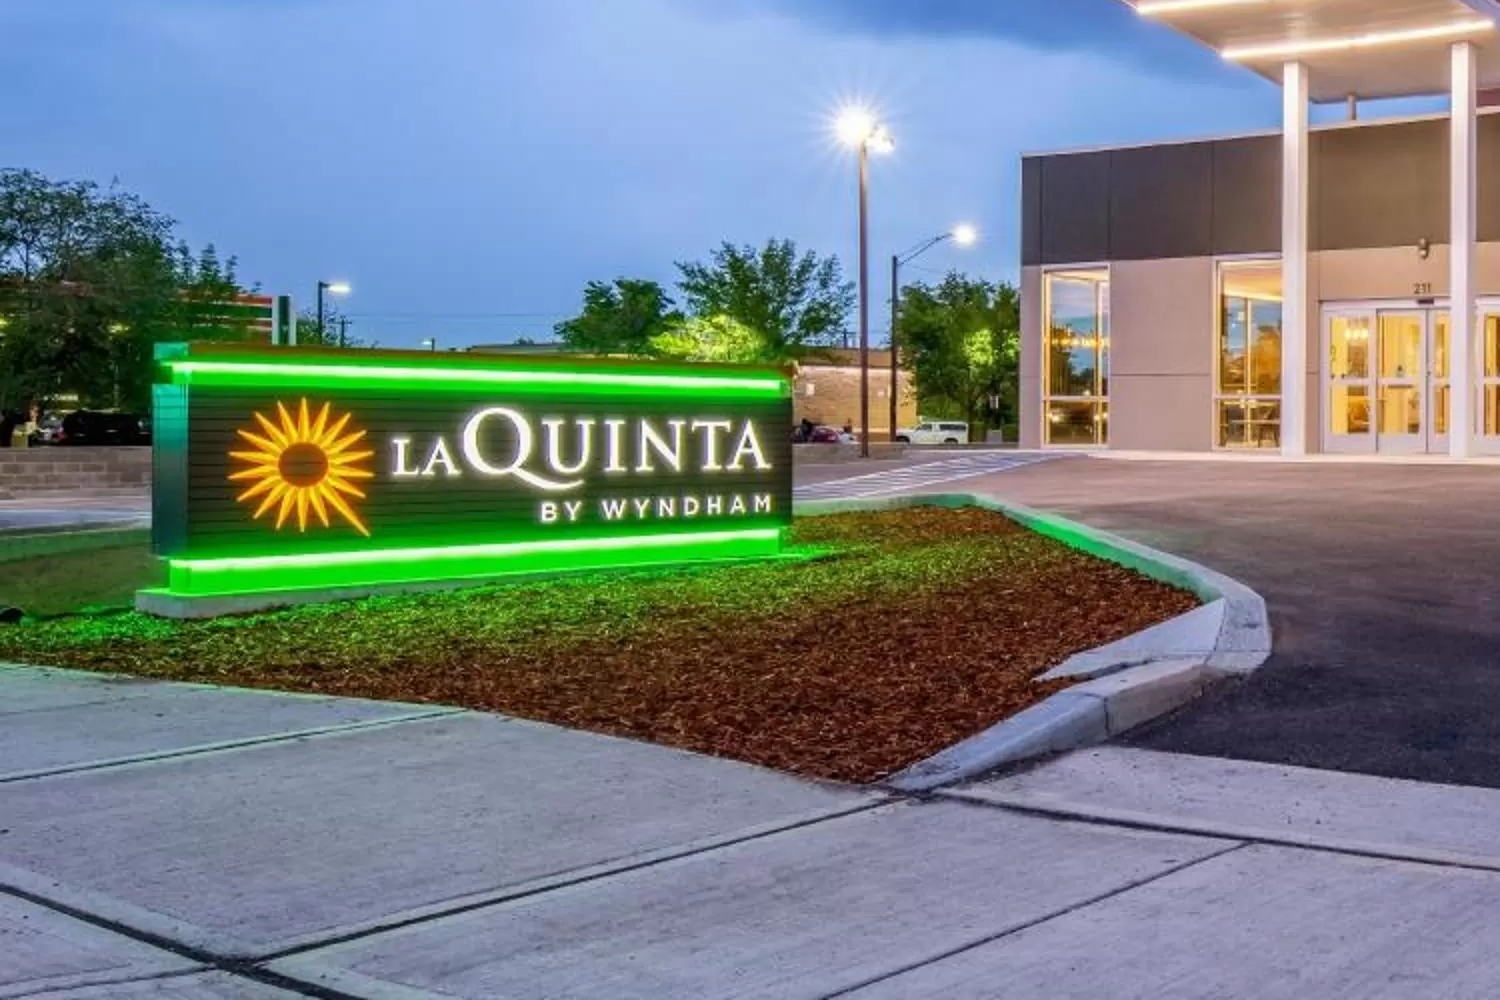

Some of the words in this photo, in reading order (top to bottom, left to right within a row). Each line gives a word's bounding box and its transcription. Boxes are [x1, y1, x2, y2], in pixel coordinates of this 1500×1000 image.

[391, 437, 461, 477] LA
[462, 407, 773, 490] QUINTA
[541, 501, 582, 523] BY
[602, 494, 772, 520] WYNDHAM
